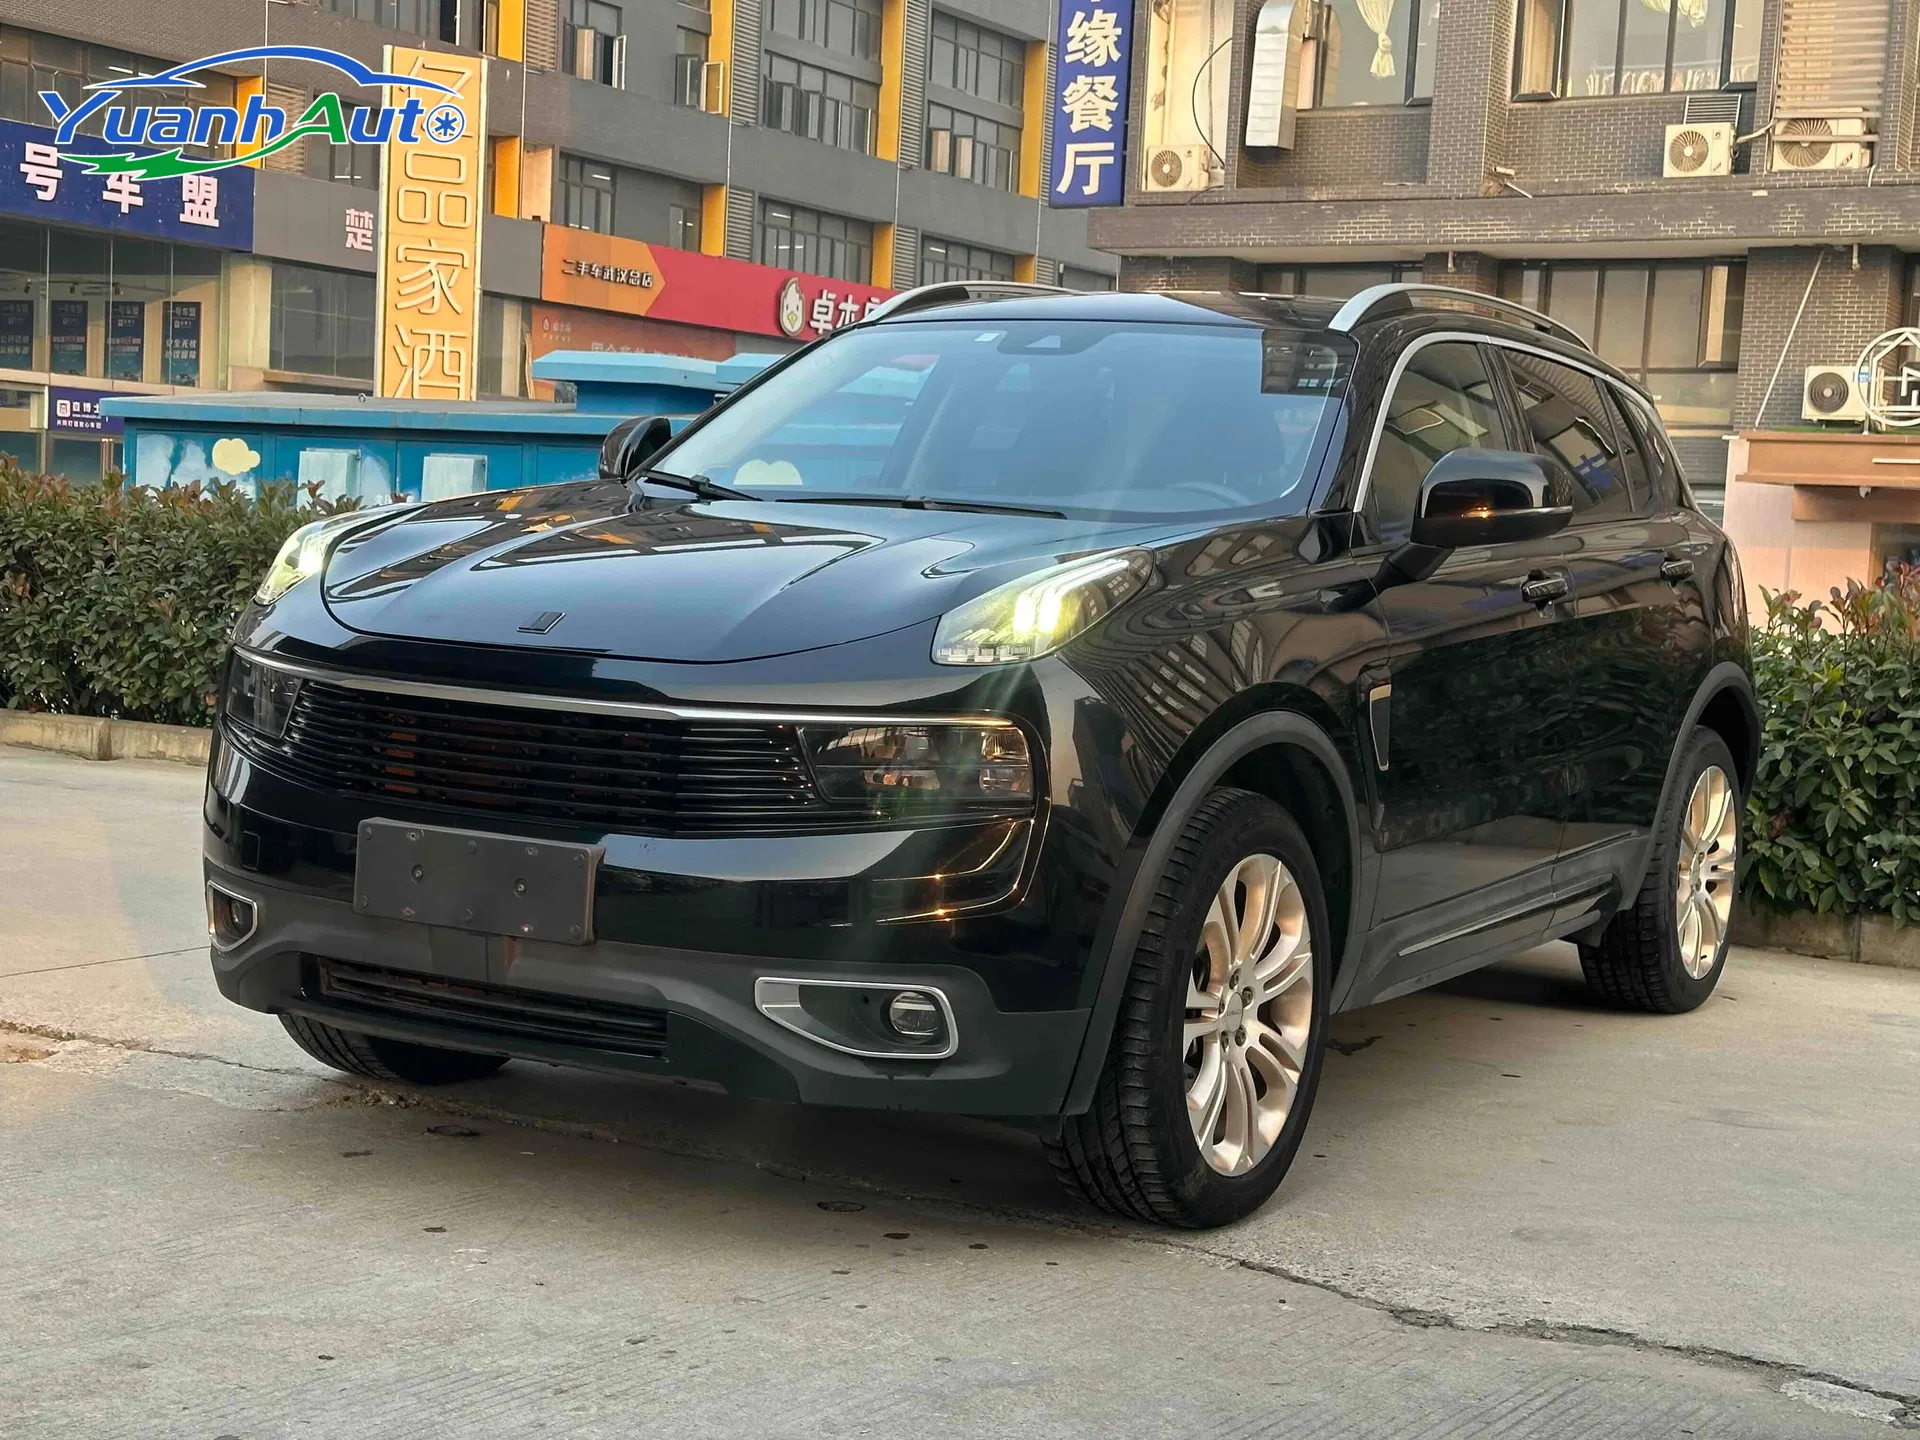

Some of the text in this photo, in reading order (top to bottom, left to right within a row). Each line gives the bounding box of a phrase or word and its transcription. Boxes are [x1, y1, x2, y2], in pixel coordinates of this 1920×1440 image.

[1056, 0, 1122, 195] 缘餐厅
[19, 142, 220, 228] 号车盟
[345, 208, 374, 252] 楚
[562, 259, 653, 288] 二手车武汉总店
